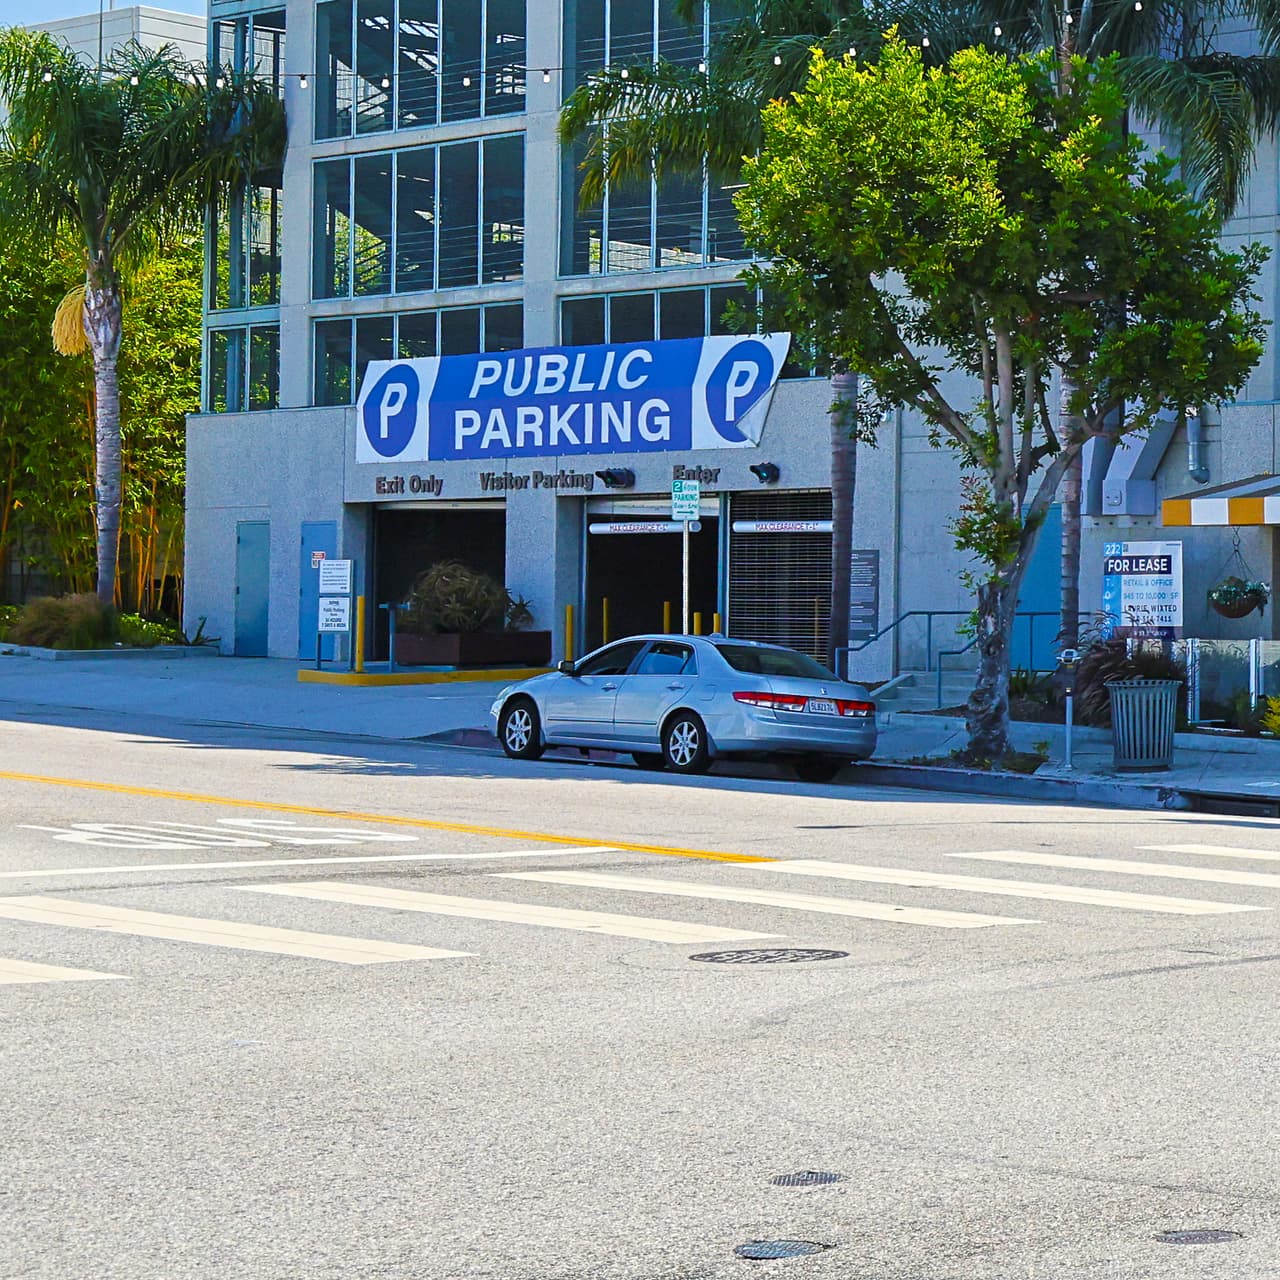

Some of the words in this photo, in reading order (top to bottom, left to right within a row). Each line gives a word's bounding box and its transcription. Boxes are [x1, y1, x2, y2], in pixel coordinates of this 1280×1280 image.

[469, 349, 653, 398] PUBLIC
[726, 361, 760, 422] P
[380, 383, 408, 439] P
[454, 399, 671, 450] PARKING
[480, 471, 530, 491] Visitor
[532, 469, 594, 491] Parking
[673, 465, 721, 484] Enter
[375, 475, 405, 495] Exit
[409, 475, 443, 497] Only
[674, 482, 681, 491] 2
[1108, 559, 1130, 572] FOR
[1132, 558, 1168, 572] LEASE
